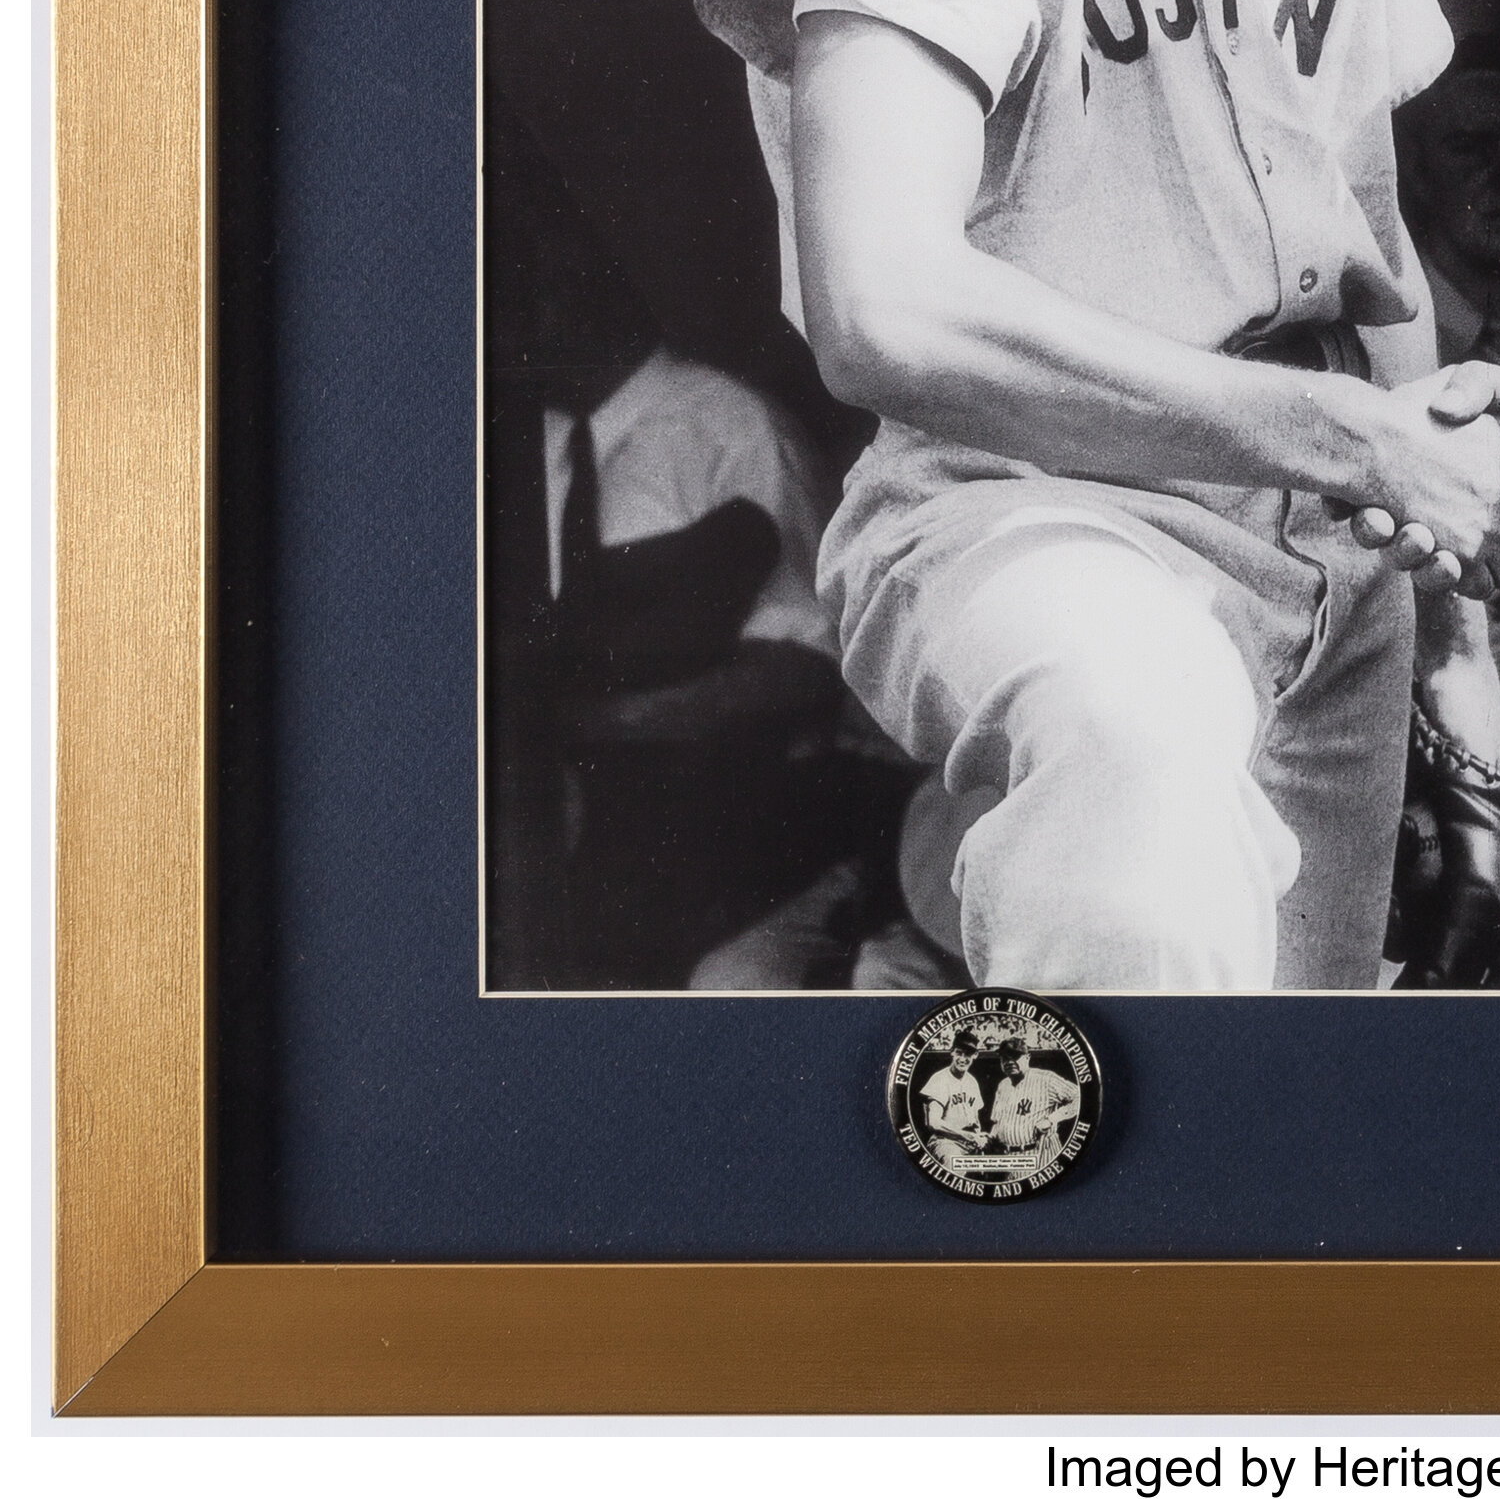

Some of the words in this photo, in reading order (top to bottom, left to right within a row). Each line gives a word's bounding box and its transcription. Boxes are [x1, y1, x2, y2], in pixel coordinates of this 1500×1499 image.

[896, 1042, 922, 1086] FIRST
[919, 999, 978, 1043] MEETING
[983, 997, 1002, 1012] OF
[1006, 999, 1037, 1019] TWO
[1040, 1013, 1093, 1085] CHAMPIONS
[900, 1123, 921, 1153] TED
[919, 1154, 985, 1198] WILLIAMS
[993, 1182, 1022, 1198] AND
[1030, 1161, 1064, 1190] BABE
[1065, 1120, 1091, 1160] RUTH
